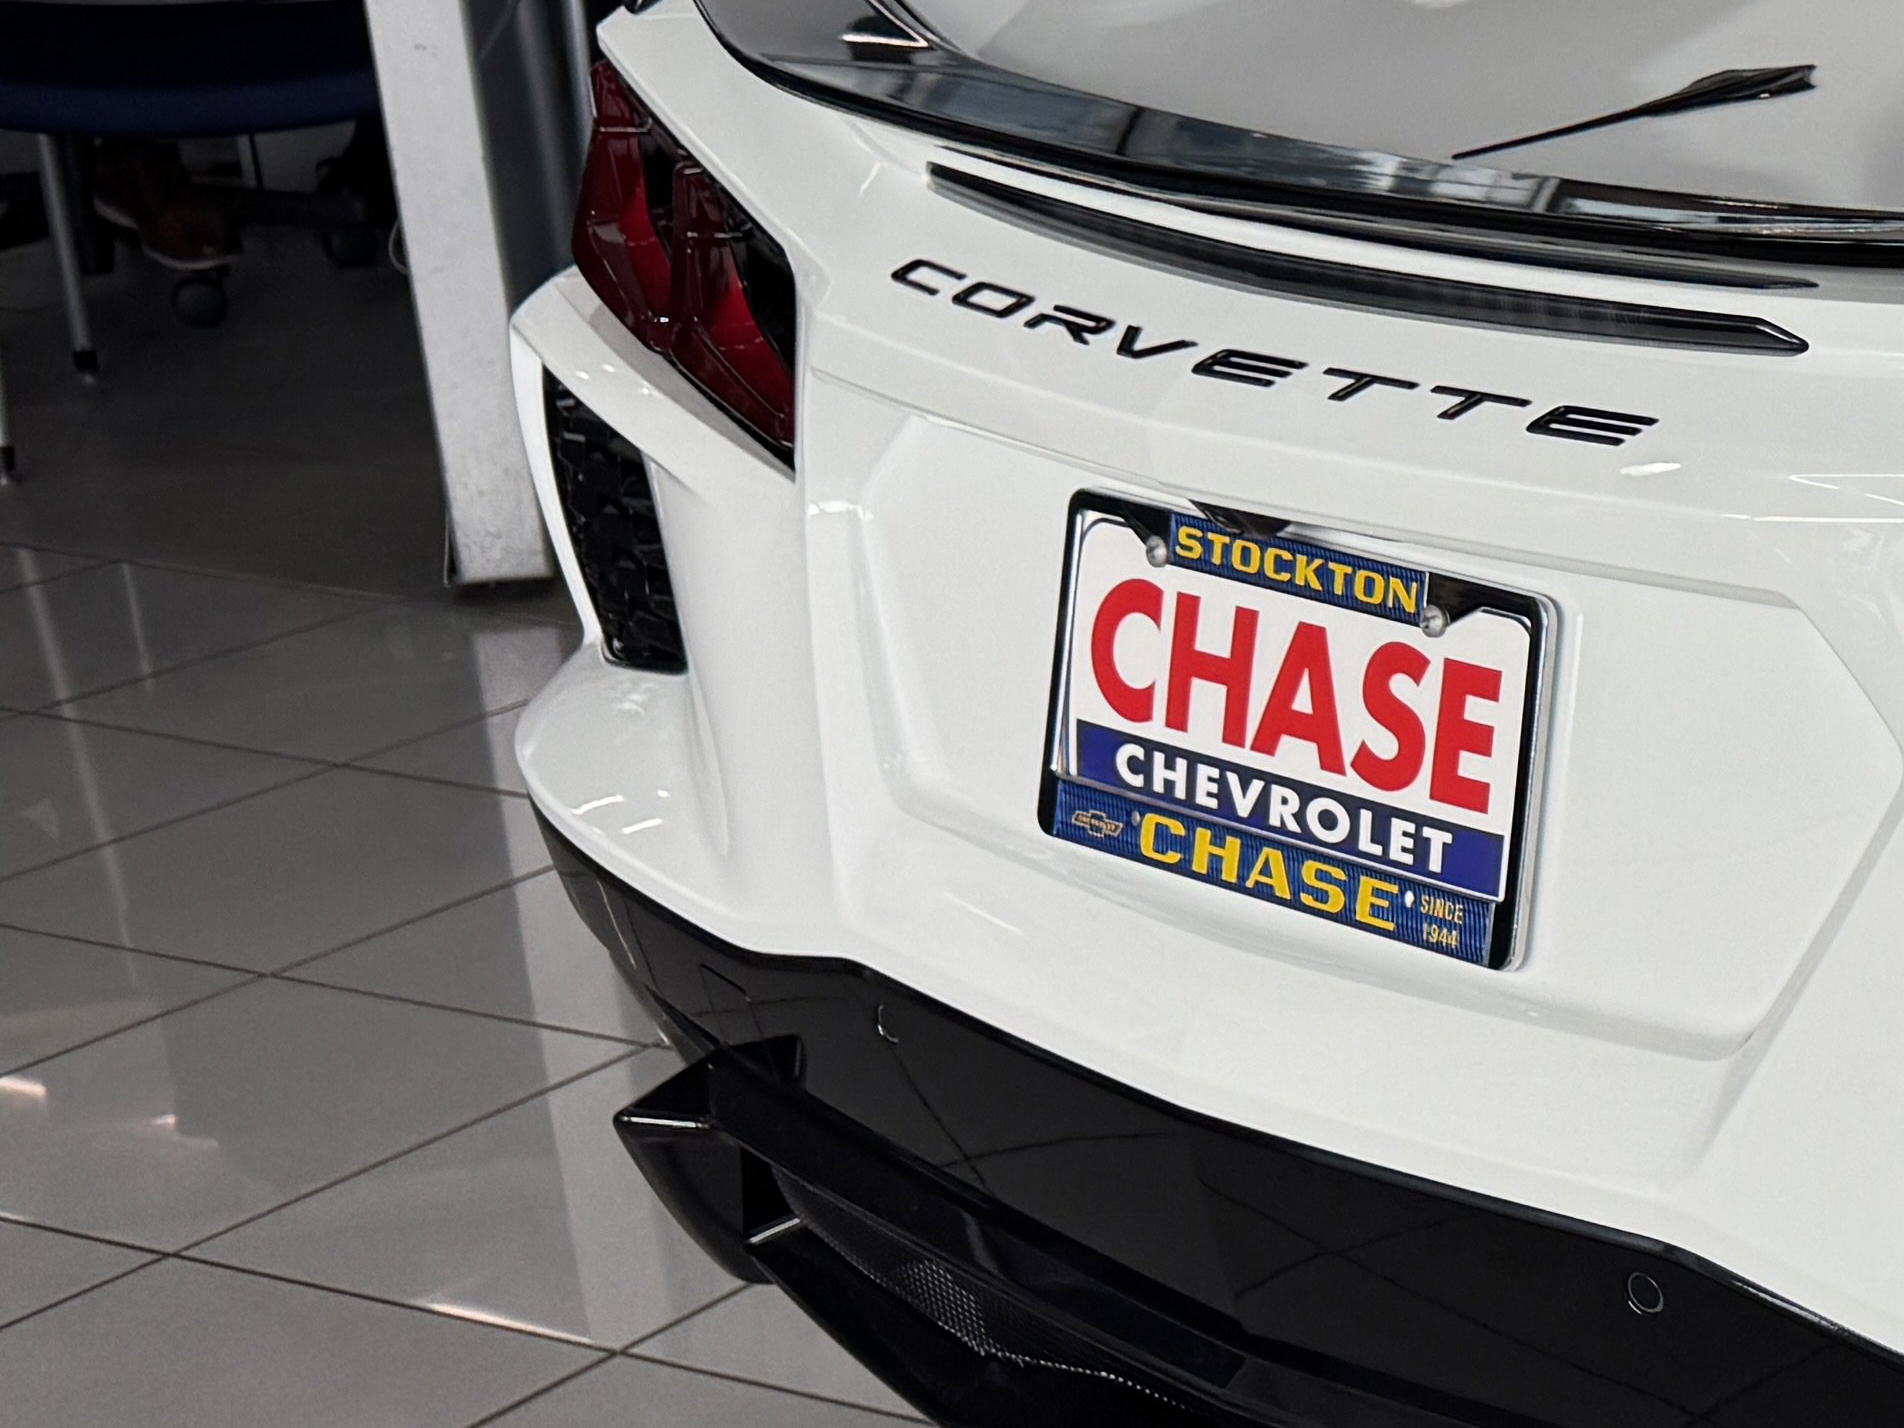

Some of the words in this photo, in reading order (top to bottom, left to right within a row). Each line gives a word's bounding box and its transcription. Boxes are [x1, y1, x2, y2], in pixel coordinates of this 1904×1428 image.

[892, 258, 1660, 447] CORVETTE
[1176, 525, 1420, 614] STOCKTON
[1090, 577, 1503, 815] CHASE
[1115, 743, 1454, 874] CHEVROLET
[1139, 812, 1400, 931] CHASE
[1420, 894, 1464, 925] SINCE
[1422, 922, 1459, 948] 1944
